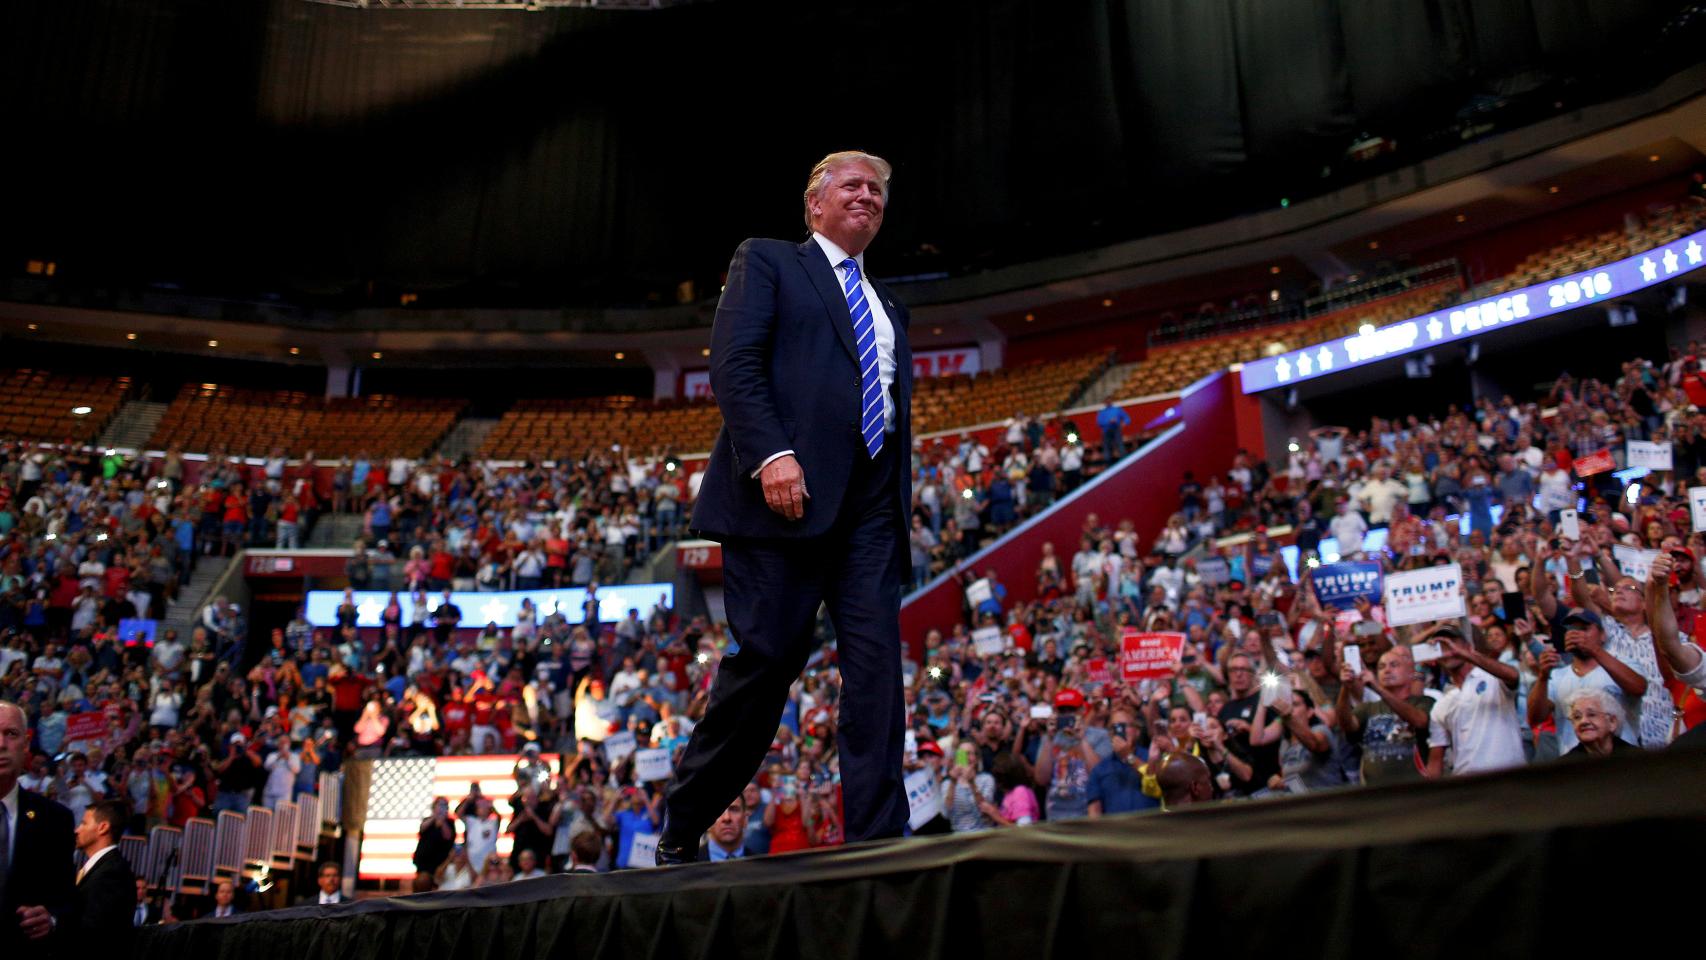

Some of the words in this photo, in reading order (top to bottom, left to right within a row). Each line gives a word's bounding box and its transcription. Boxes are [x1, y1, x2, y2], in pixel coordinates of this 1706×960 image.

[1449, 293, 1530, 336] PENCE
[1548, 272, 1612, 308] 2016
[1314, 571, 1378, 588] TRUMP
[1391, 580, 1456, 597] TRUMP
[1395, 592, 1451, 604] PENCE
